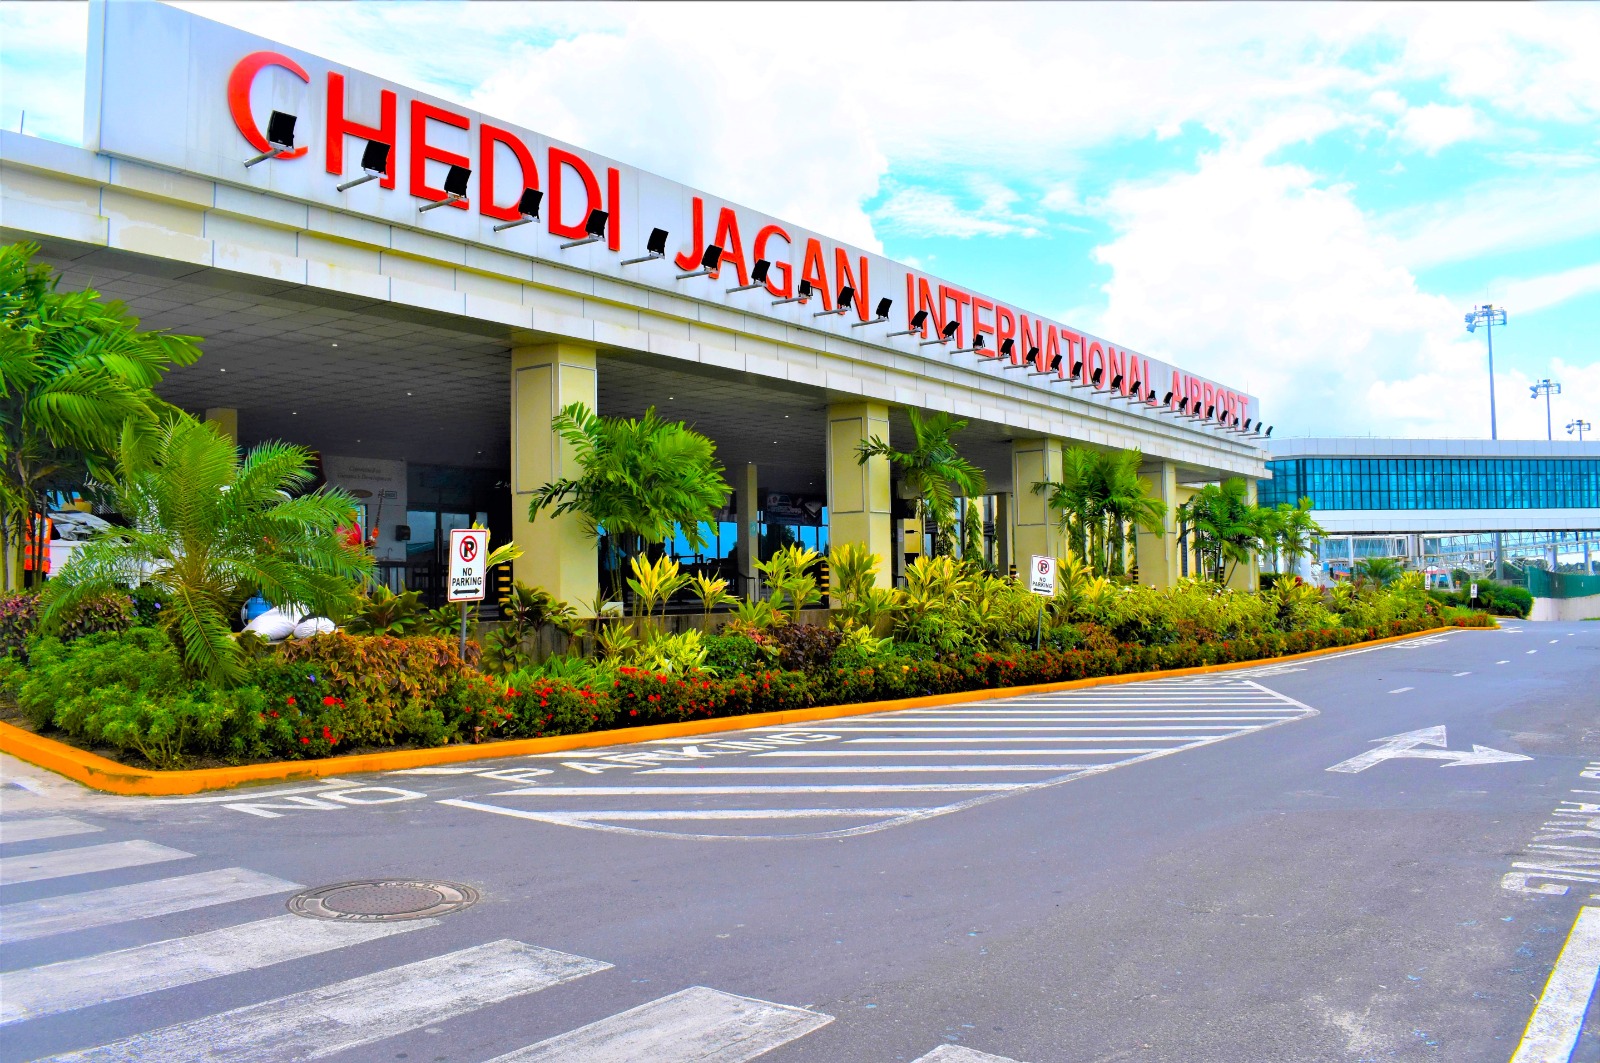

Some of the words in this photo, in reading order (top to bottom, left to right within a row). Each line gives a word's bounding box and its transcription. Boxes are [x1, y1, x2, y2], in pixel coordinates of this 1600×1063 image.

[227, 51, 621, 252] CHEDDI
[674, 196, 870, 322] JAGAN
[906, 273, 1158, 407] INTERNATIONAL
[1170, 370, 1249, 431] AIRPORT
[462, 567, 473, 577] NO
[452, 577, 482, 587] PARKING
[1032, 580, 1053, 589] PARKING
[220, 786, 428, 818] NO
[473, 731, 842, 784] PARKING
